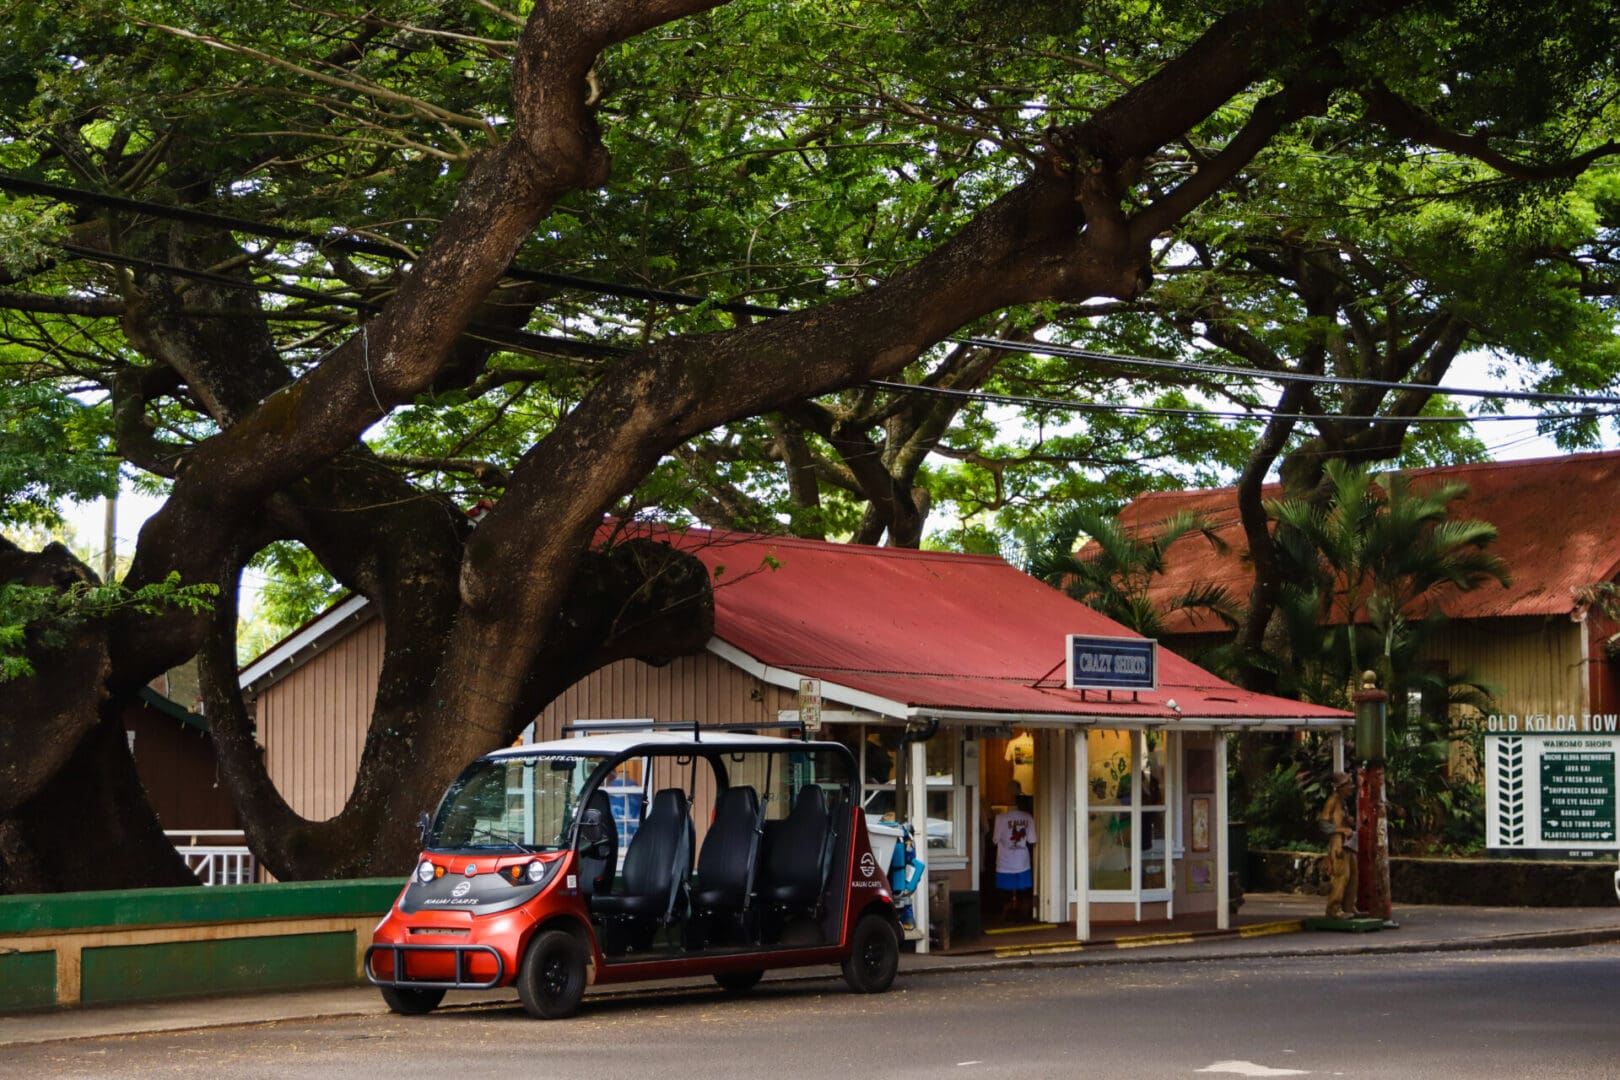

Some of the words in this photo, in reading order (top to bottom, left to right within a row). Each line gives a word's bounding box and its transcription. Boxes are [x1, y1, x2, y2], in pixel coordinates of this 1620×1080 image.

[1080, 653, 1112, 672] CRAZY
[1114, 654, 1146, 674] SHIRTS
[1488, 714, 1518, 732] OLD
[1583, 714, 1620, 732] TOW
[1542, 740, 1583, 748] WAIKOMO
[1585, 740, 1612, 748] SHOPS
[1561, 820, 1573, 828] OLD
[1574, 820, 1590, 828] TOWN
[1592, 820, 1611, 828] SHOPS
